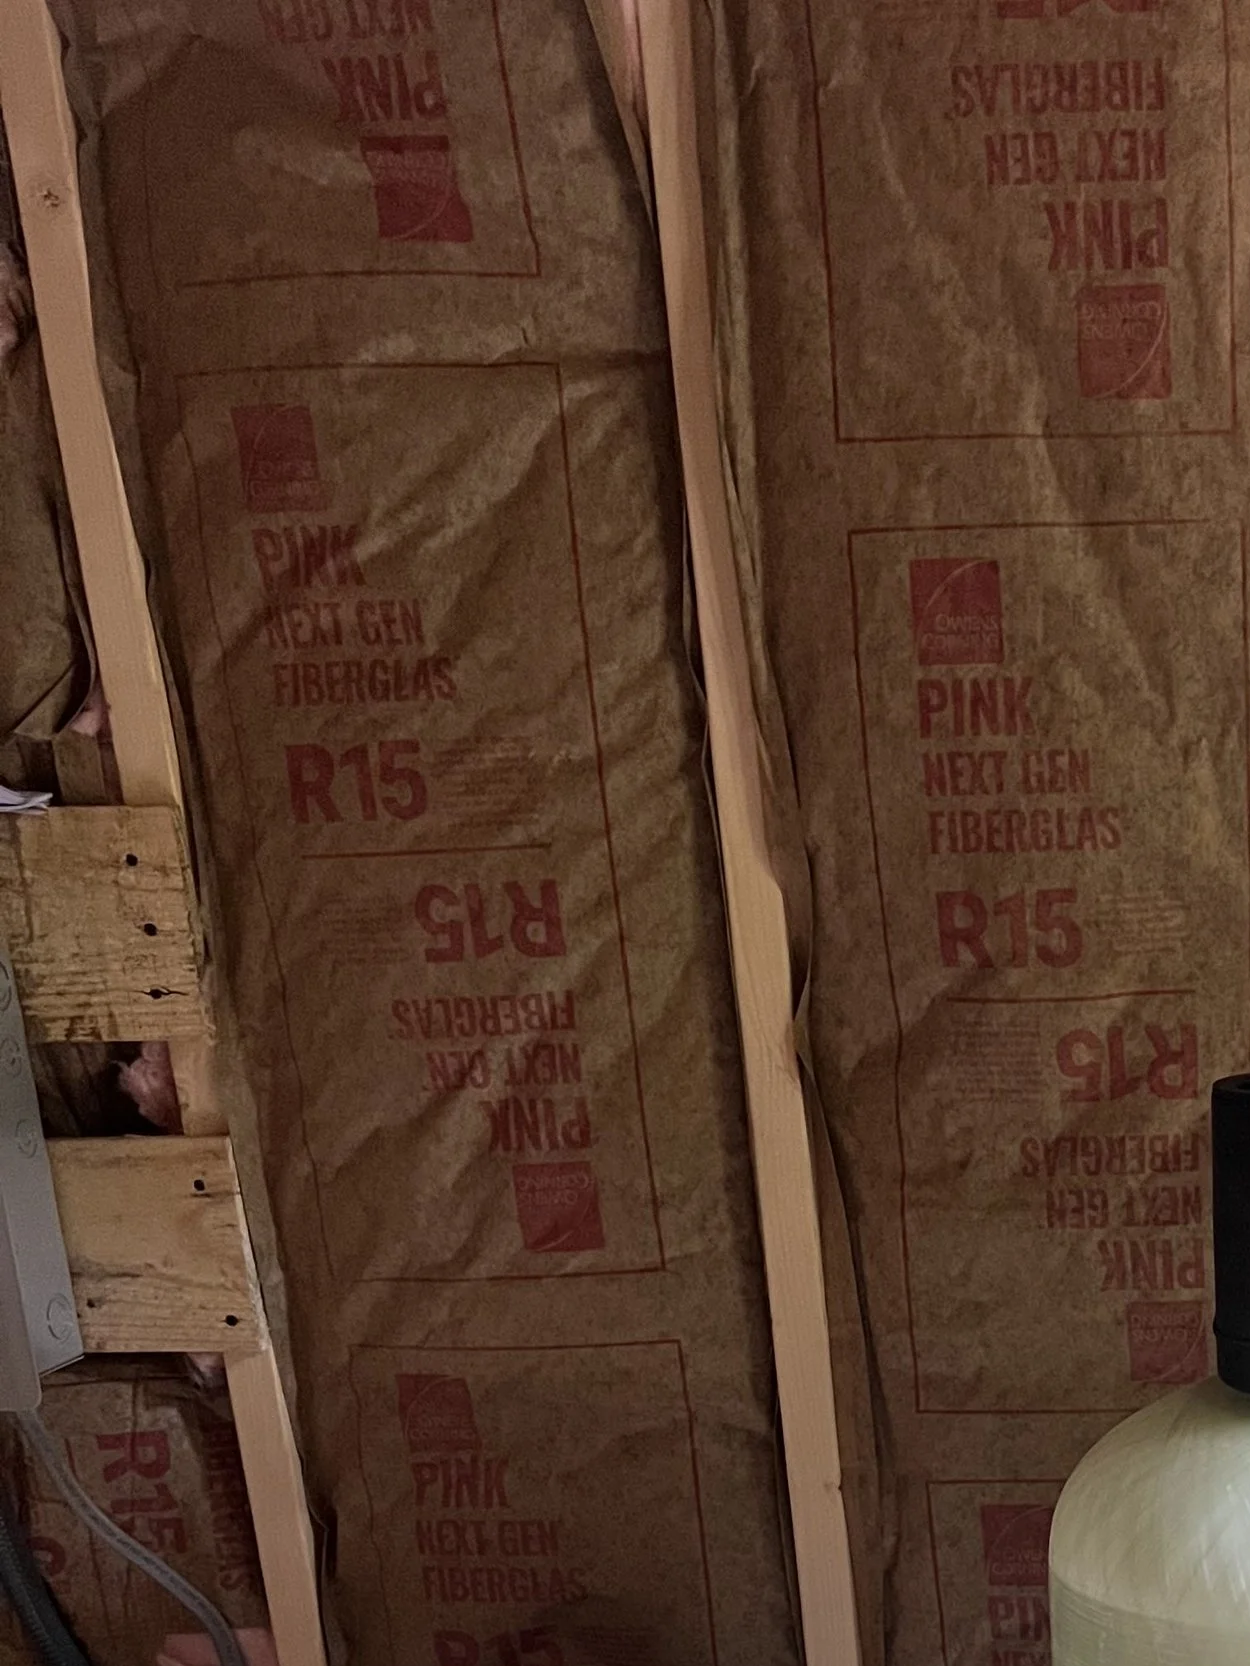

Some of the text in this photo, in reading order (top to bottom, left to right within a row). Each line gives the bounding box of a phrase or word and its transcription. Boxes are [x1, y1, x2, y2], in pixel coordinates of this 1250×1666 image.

[320, 50, 448, 126] PINK
[951, 61, 1166, 118] FIBERGLAS
[986, 129, 1167, 187] NEXT GEN
[1047, 198, 1170, 271] PINK
[250, 523, 367, 593] PINK
[265, 598, 426, 650] NEXT GEN
[272, 656, 459, 707] FIBERGLAS
[916, 675, 1037, 740] PINK
[284, 738, 428, 825] R15
[922, 748, 1091, 798] NEXT GEN
[928, 806, 1123, 855] FIBERGLAS
[413, 878, 567, 964] R15
[935, 887, 1085, 969] R15
[390, 989, 577, 1041] FIBERGLAS
[503, 1042, 583, 1088] NEXT
[1056, 1023, 1199, 1102] R15
[1019, 1133, 1202, 1178] FIBERGLAS
[1046, 1186, 1201, 1230] NEXT GEN
[1100, 1238, 1206, 1292] PINK
[411, 1452, 510, 1509] PINK
[415, 1519, 560, 1557] NEXT GEN
[421, 1566, 589, 1604] FIBERGLAS
